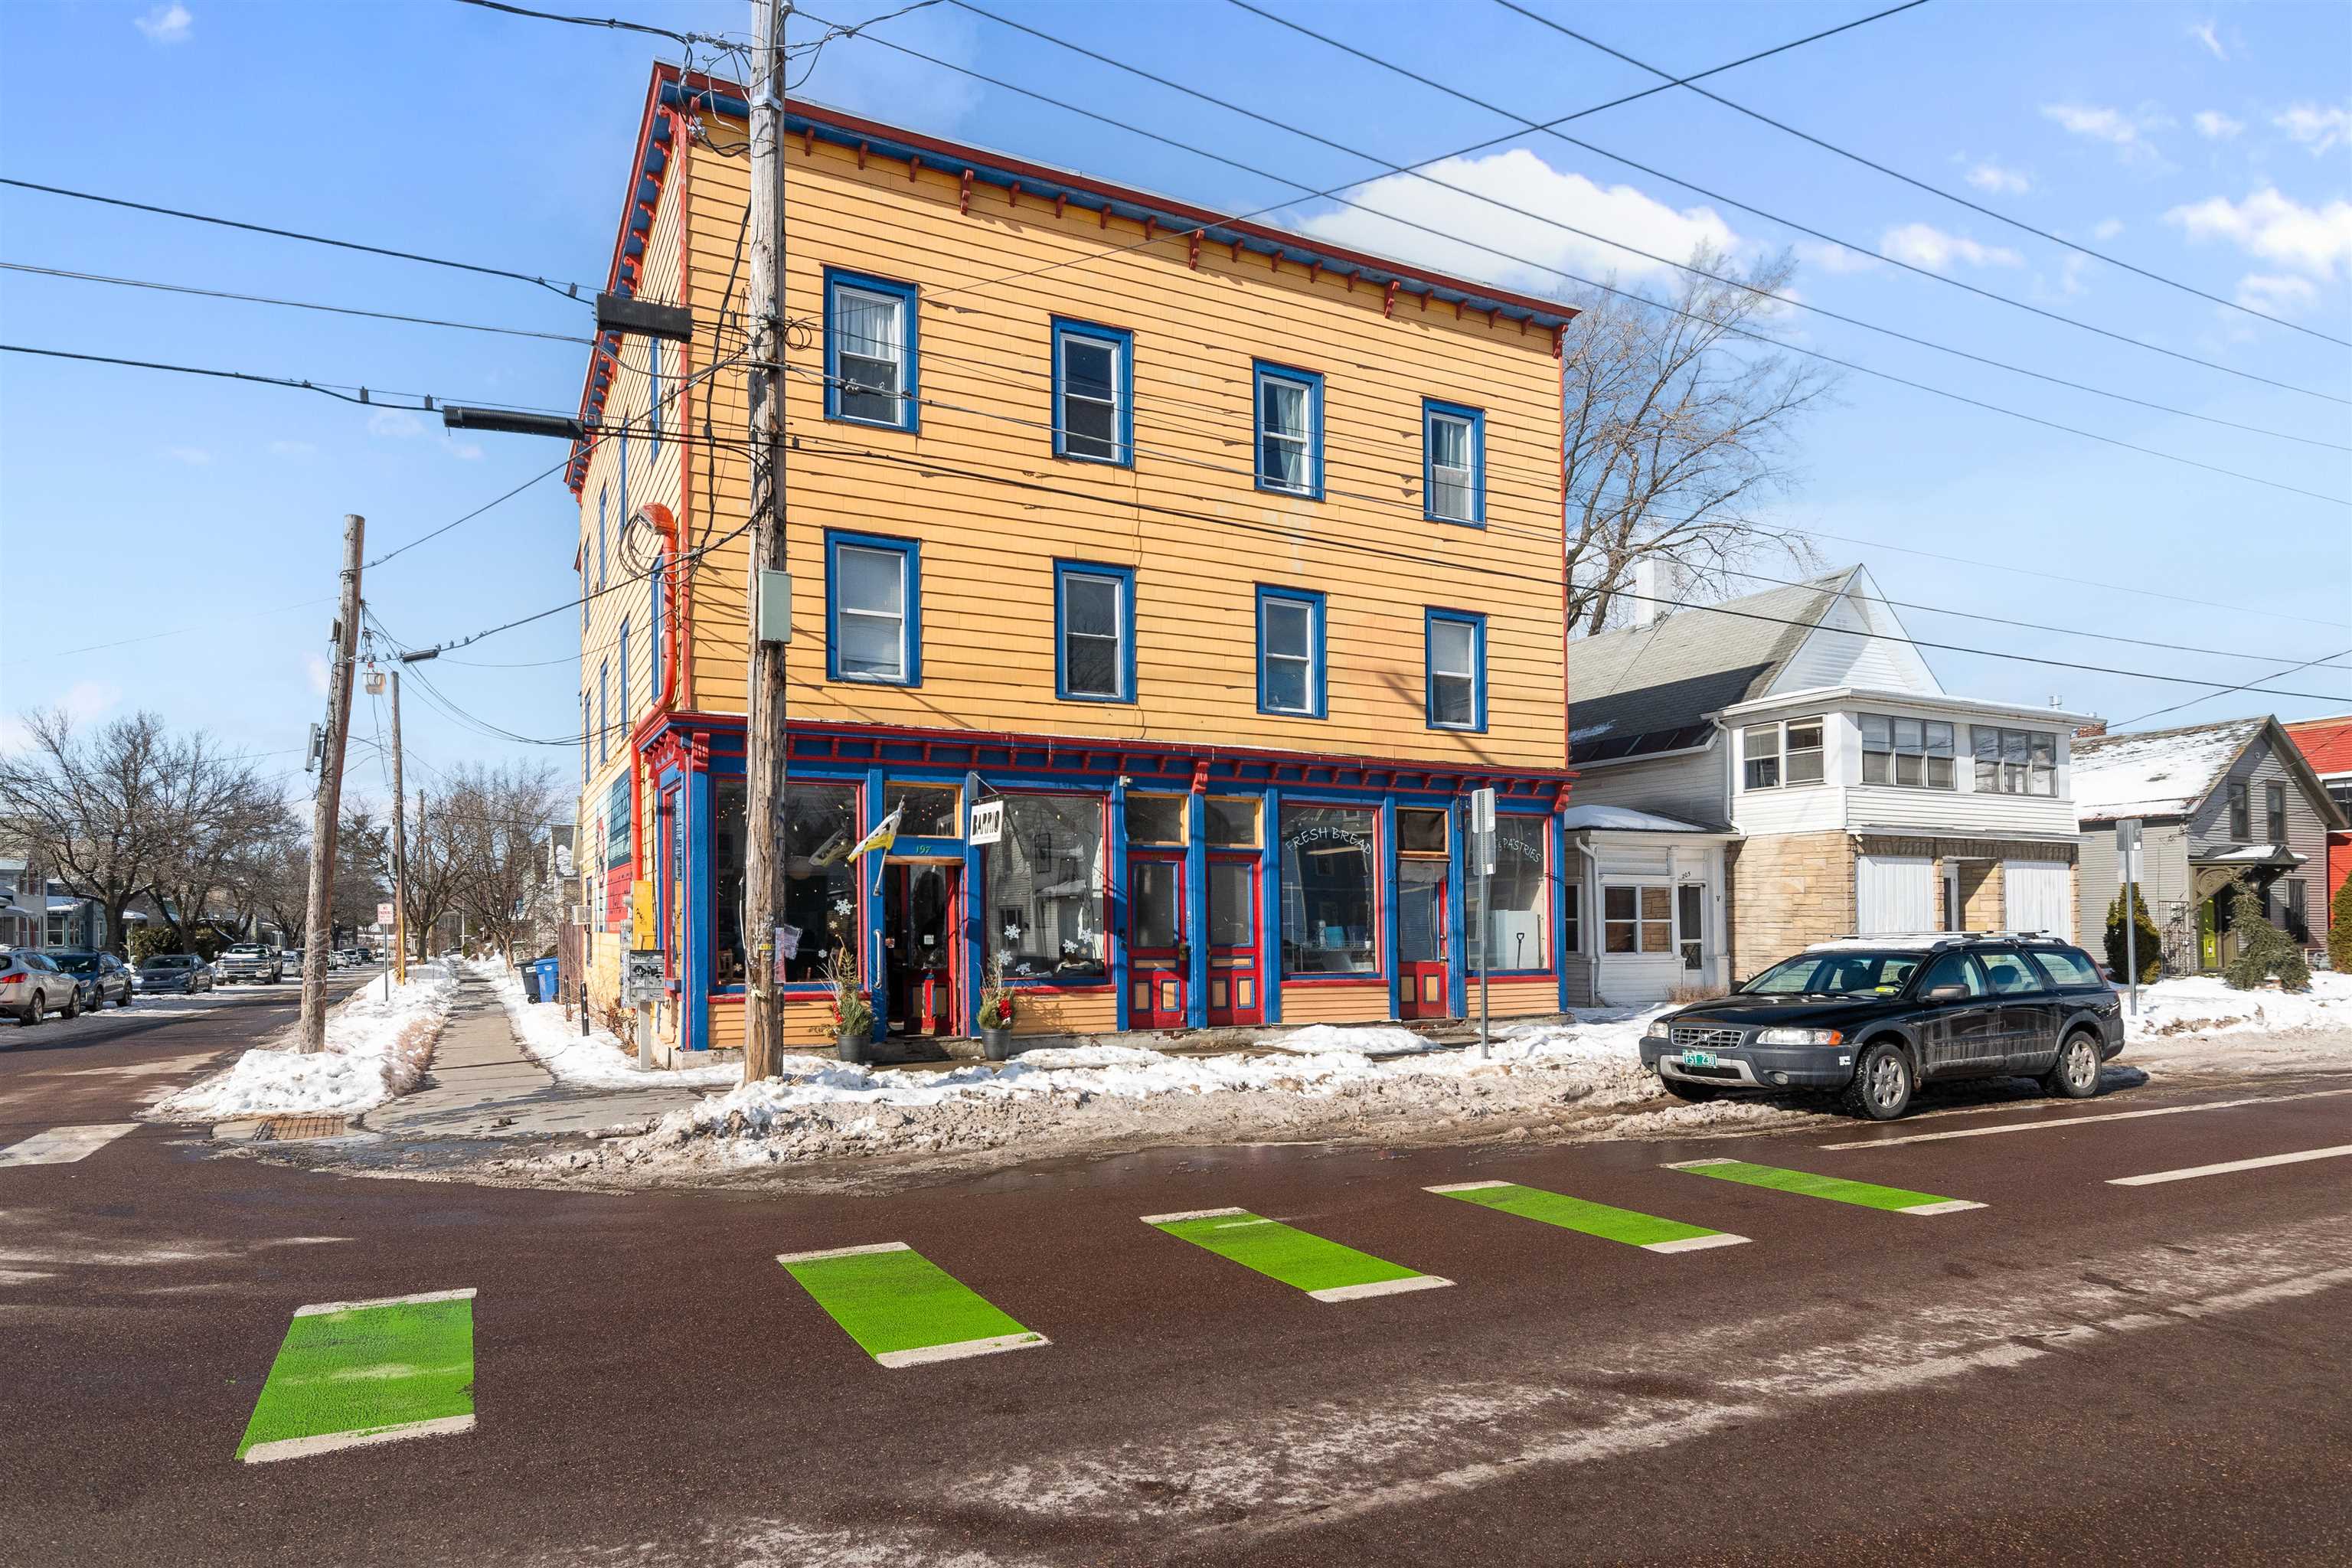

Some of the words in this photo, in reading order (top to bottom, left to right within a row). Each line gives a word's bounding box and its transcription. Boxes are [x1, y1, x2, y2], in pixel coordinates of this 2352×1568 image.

[972, 810, 999, 835] BARRIO
[915, 845, 931, 854] 197
[1285, 827, 1328, 852] FRESH
[1332, 827, 1371, 854] BREAD
[1503, 838, 1541, 862] PASTRIES
